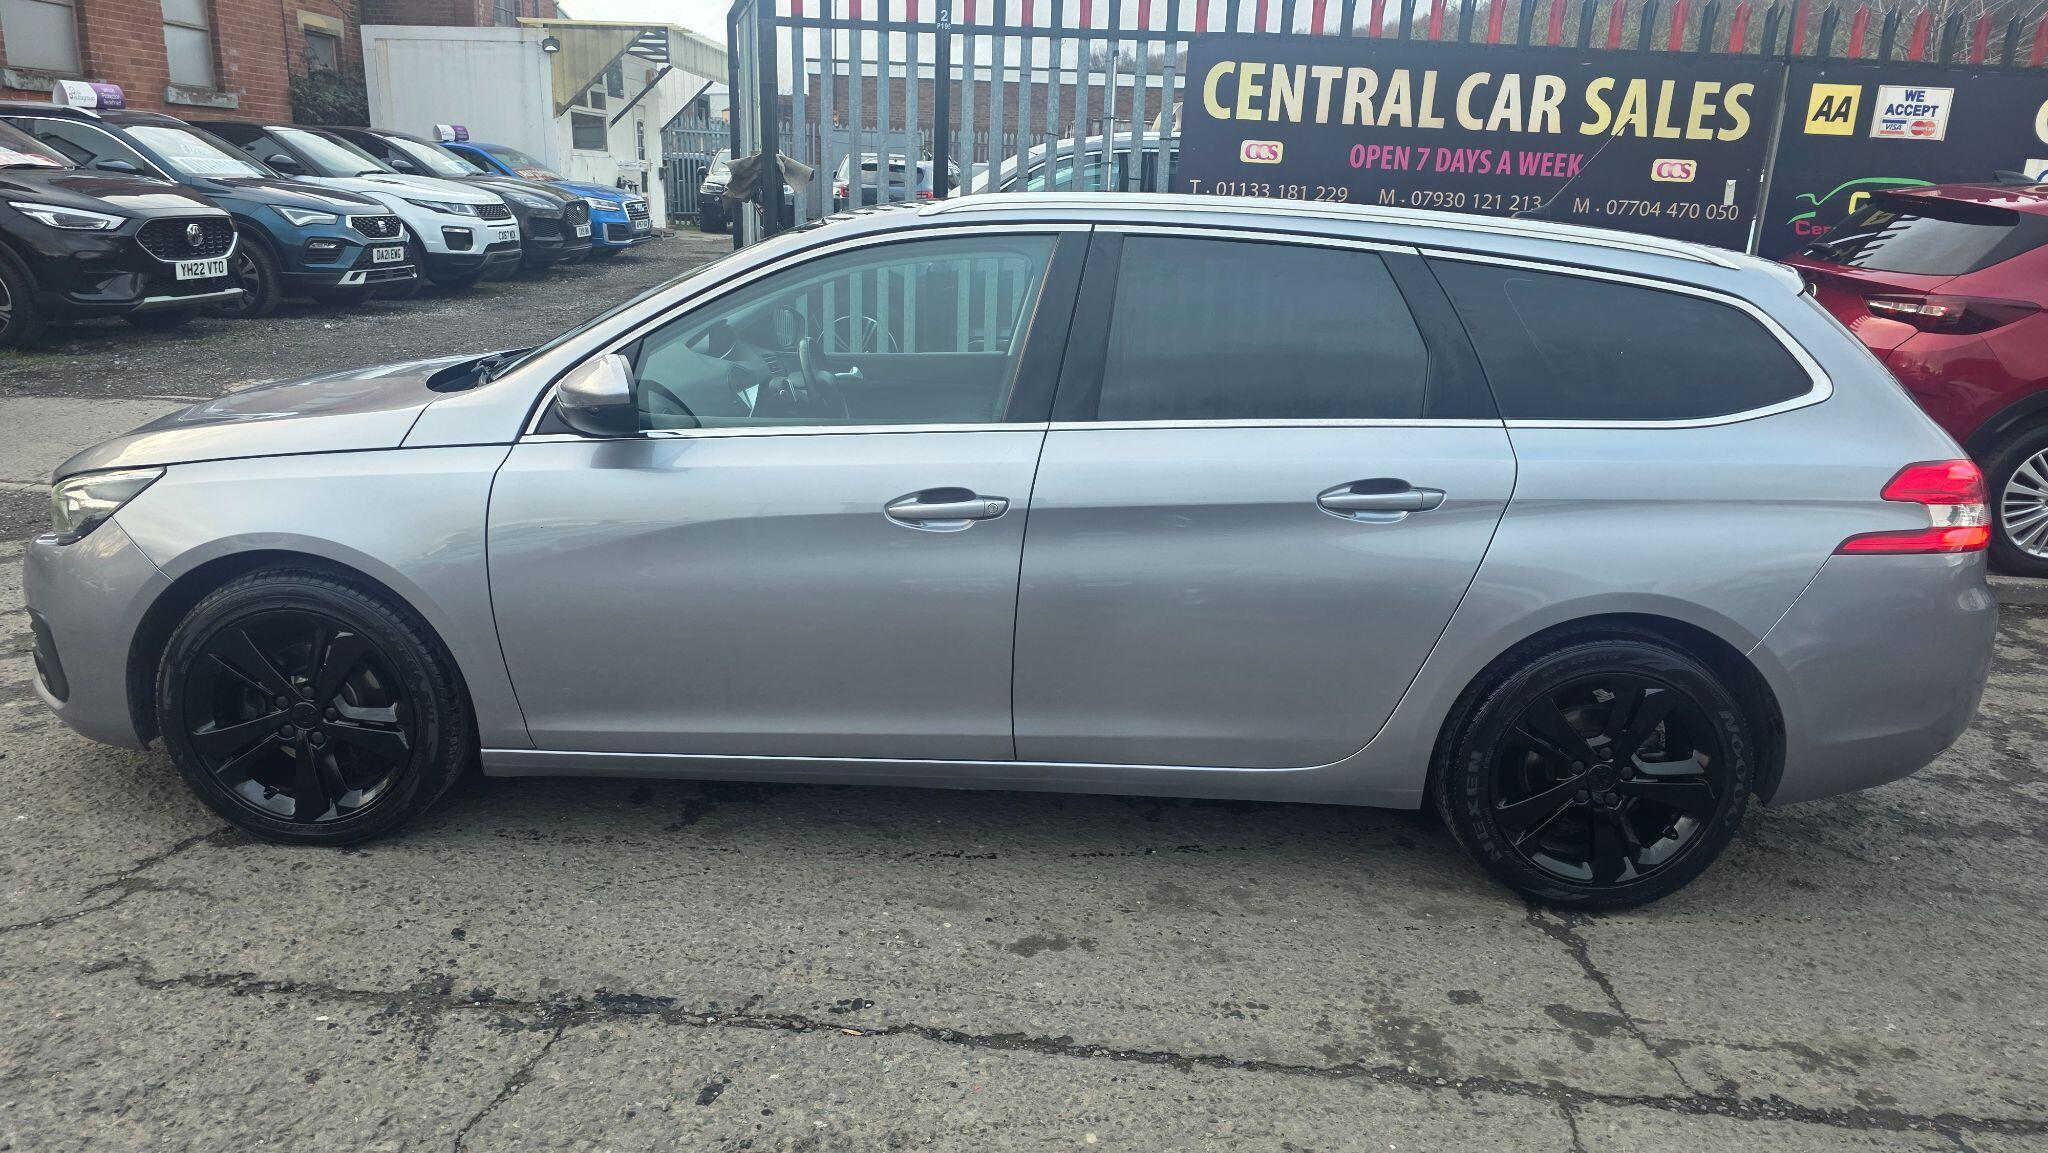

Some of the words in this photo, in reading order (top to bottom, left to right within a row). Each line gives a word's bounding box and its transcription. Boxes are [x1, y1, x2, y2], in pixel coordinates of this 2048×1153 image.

[940, 9, 948, 21] 2
[1203, 60, 1445, 129] CENTRAL
[1456, 72, 1567, 134] CAR
[1579, 76, 1755, 142] SALES
[1905, 89, 1926, 102] WE
[1811, 95, 1853, 122] AA
[1885, 103, 1939, 117] ACCEPT
[1885, 123, 1902, 131] VISA
[1245, 143, 1279, 161] CCS
[1349, 143, 1410, 172] OPEN
[1416, 147, 1430, 171] 7
[1435, 147, 1492, 174] DAYS
[1495, 150, 1511, 175] A
[1519, 151, 1584, 179] WEEK
[1656, 162, 1692, 180] CCS
[1216, 181, 1270, 198] 01133
[1278, 184, 1307, 200] 181
[1314, 186, 1348, 203] 229
[1411, 191, 1466, 208] 07930
[1473, 193, 1501, 210] 121
[1508, 195, 1542, 211] 213
[1606, 200, 1661, 217] 07704
[1666, 202, 1700, 219] 470
[1705, 205, 1739, 221] 050
[180, 262, 206, 276] YH22
[206, 260, 224, 275] VTO
